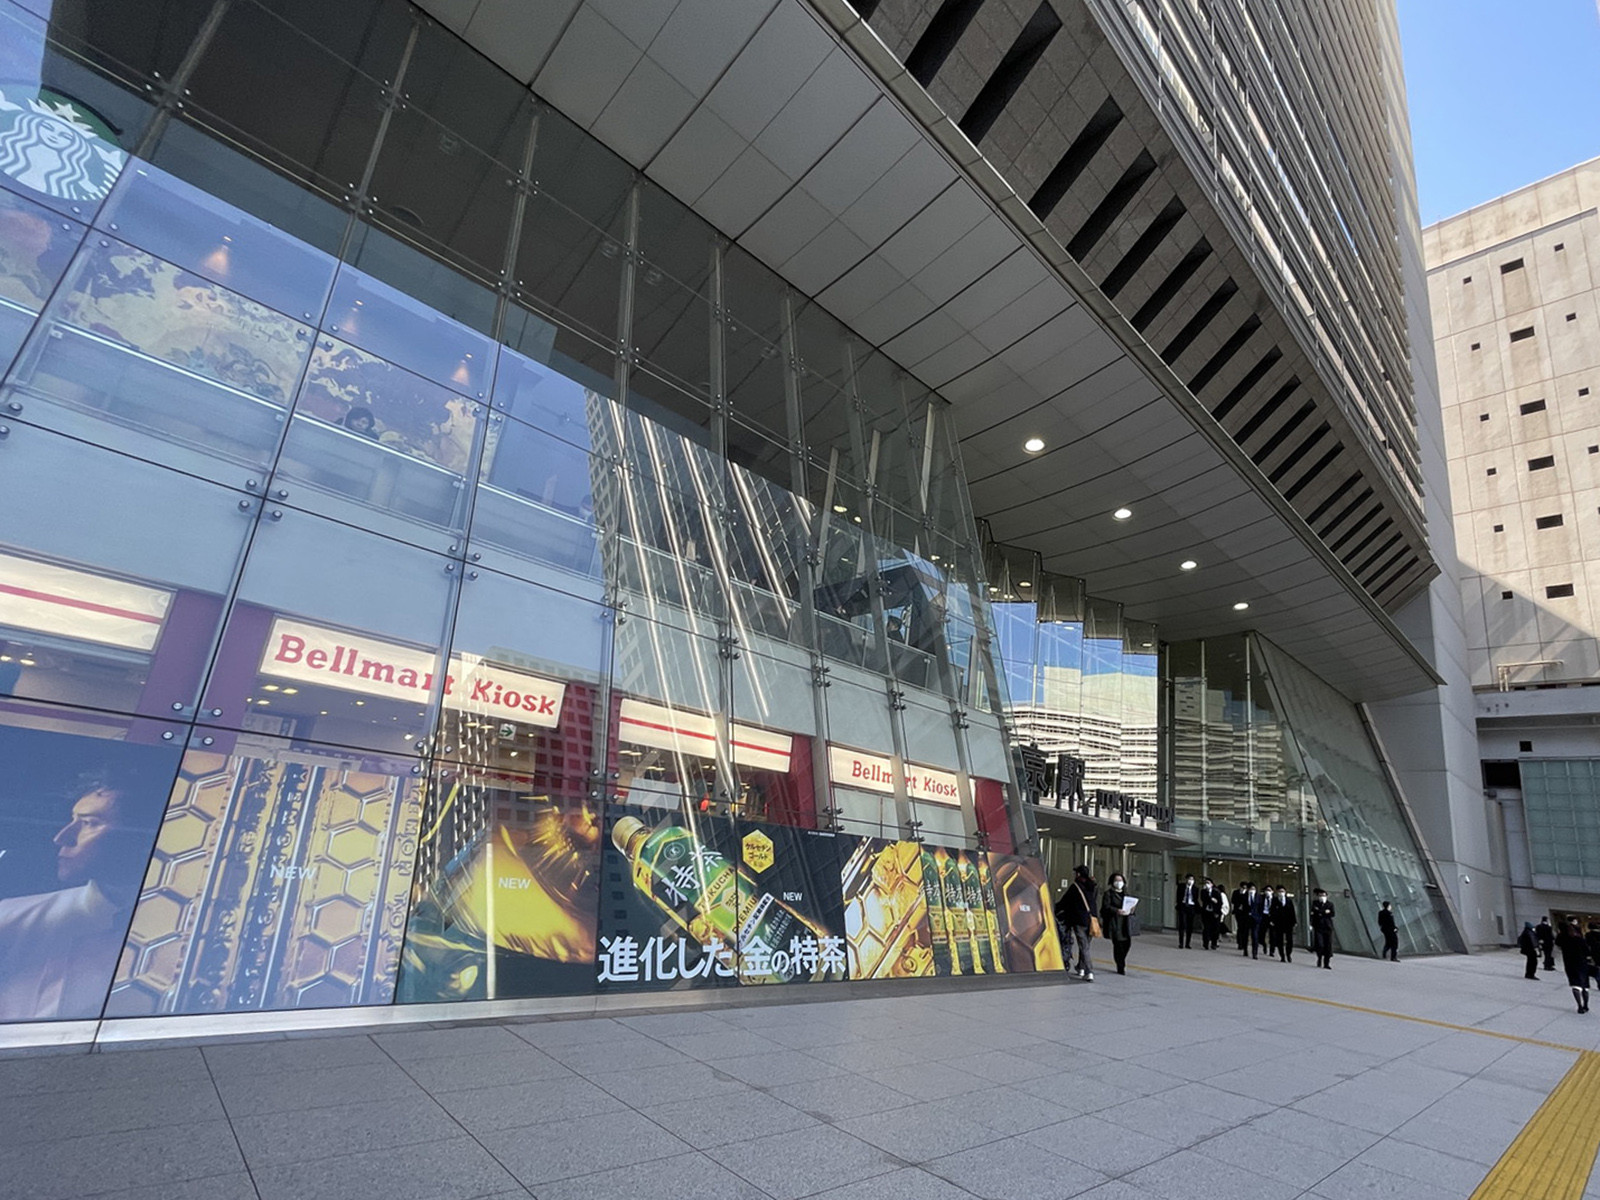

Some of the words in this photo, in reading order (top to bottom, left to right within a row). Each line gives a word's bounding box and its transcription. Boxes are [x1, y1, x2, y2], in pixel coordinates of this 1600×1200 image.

[275, 633, 454, 696] Bellmart
[470, 678, 557, 716] Kiosk
[852, 760, 917, 789] Bellmrt
[923, 777, 958, 797] Kiosk
[269, 864, 317, 882] NEW
[498, 876, 532, 891] NEW
[783, 891, 803, 902] NEW
[597, 935, 846, 984] 進化した金の特茶
